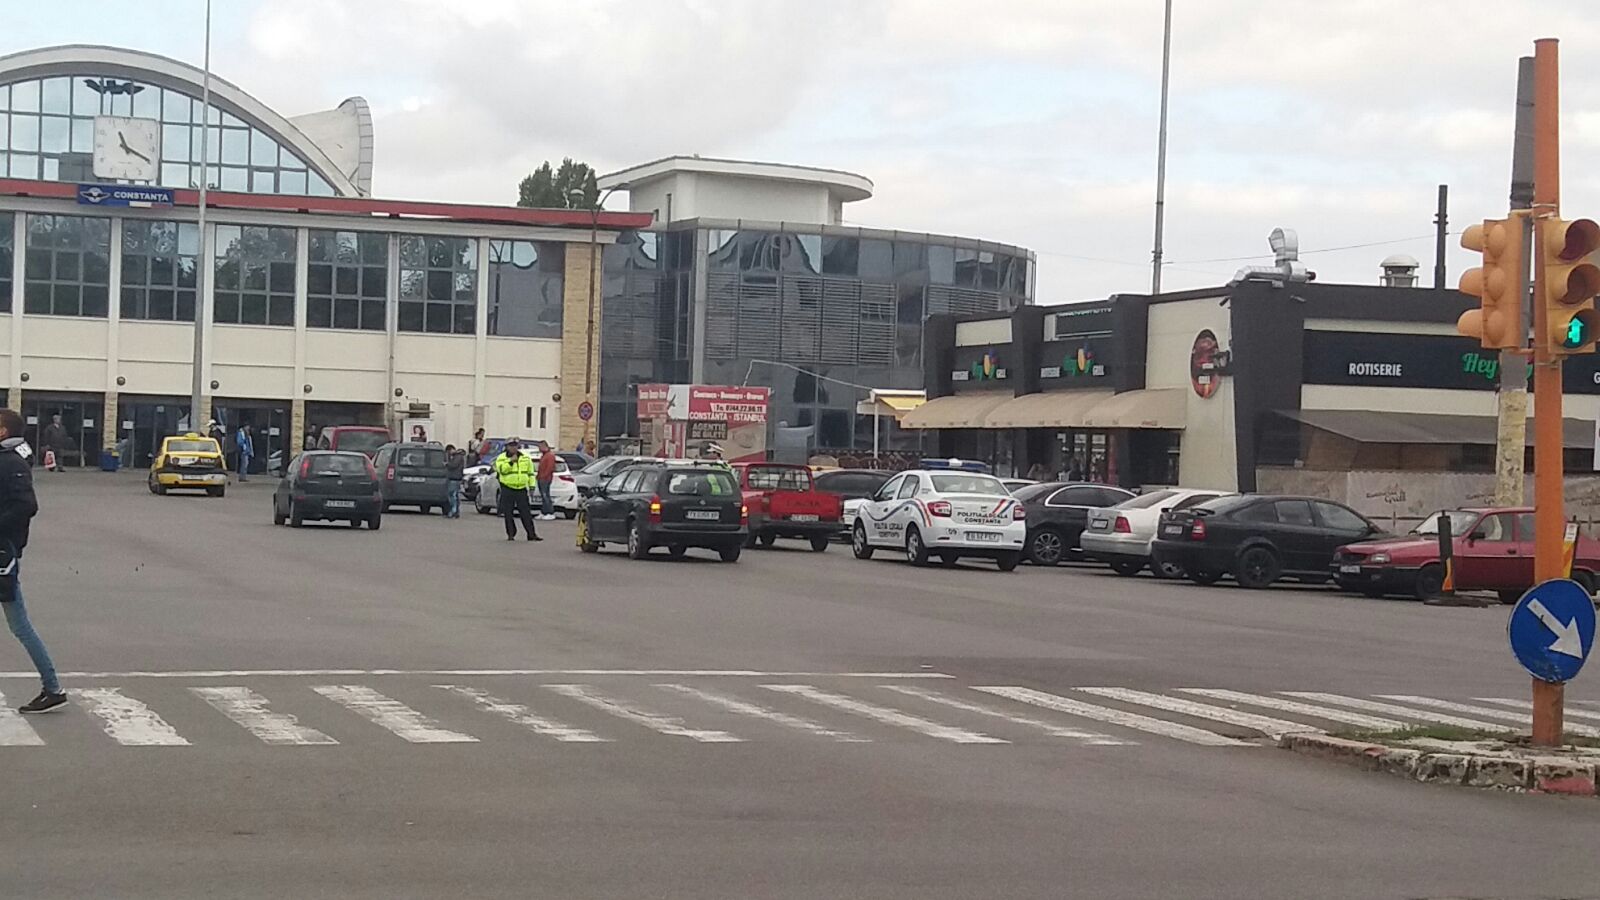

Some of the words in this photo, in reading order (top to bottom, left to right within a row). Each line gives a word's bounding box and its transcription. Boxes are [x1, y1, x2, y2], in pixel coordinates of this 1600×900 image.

[113, 191, 169, 201] CONSTANTA
[1348, 362, 1402, 376] ROTISERIE
[1462, 352, 1497, 379] Hey
